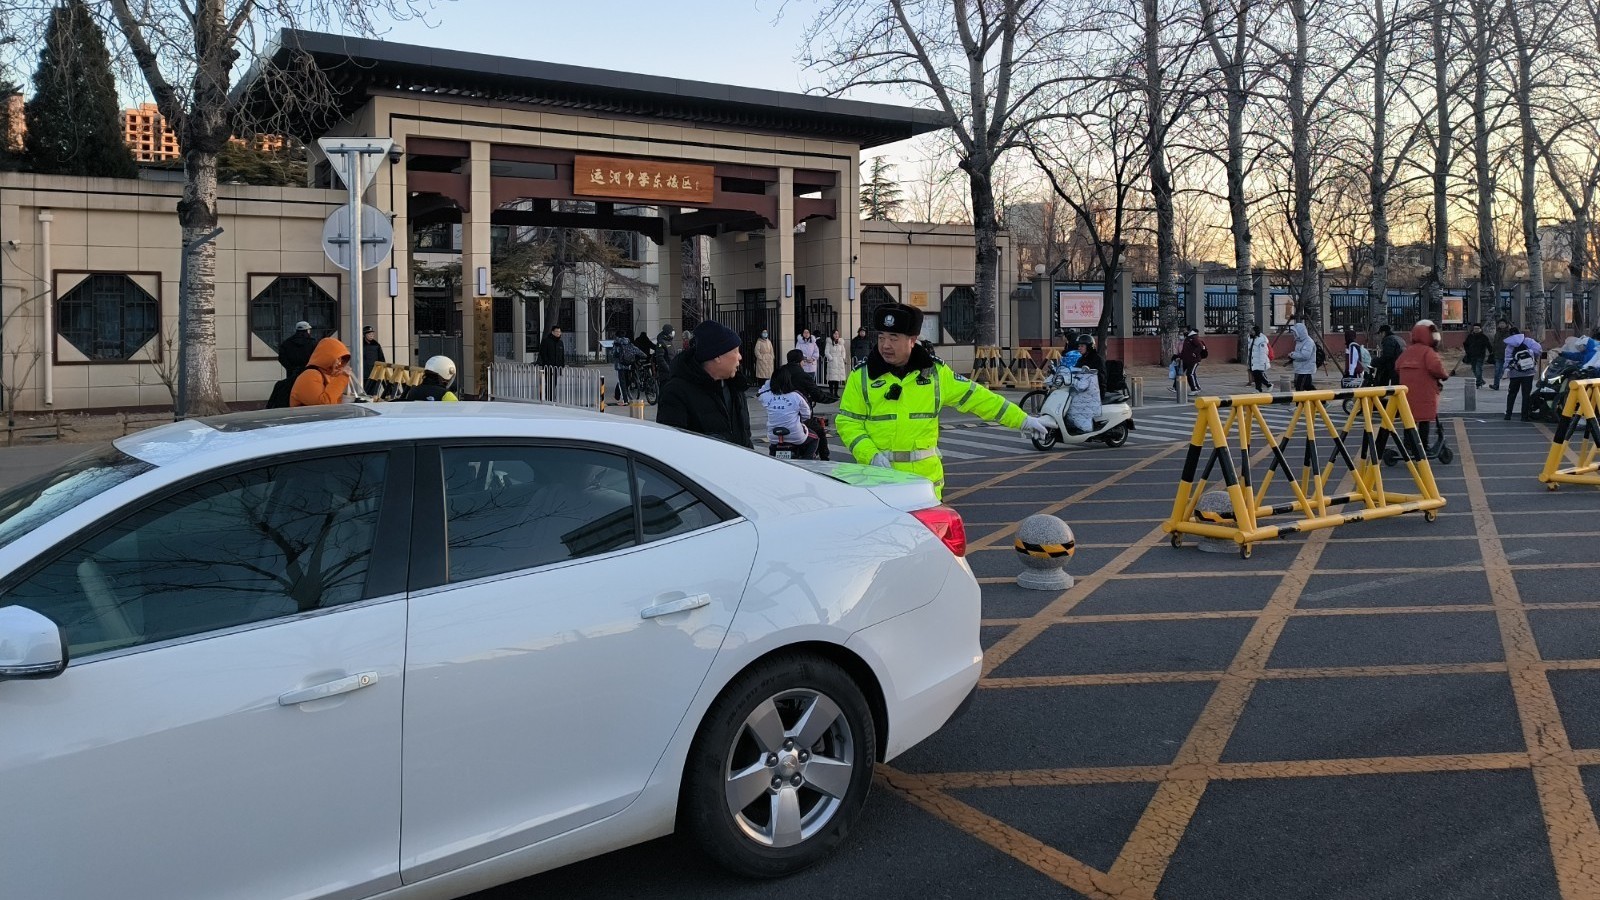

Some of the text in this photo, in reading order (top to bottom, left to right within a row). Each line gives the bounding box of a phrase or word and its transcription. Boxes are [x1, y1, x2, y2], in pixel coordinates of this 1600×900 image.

[590, 168, 693, 190] 运河中学东校区
